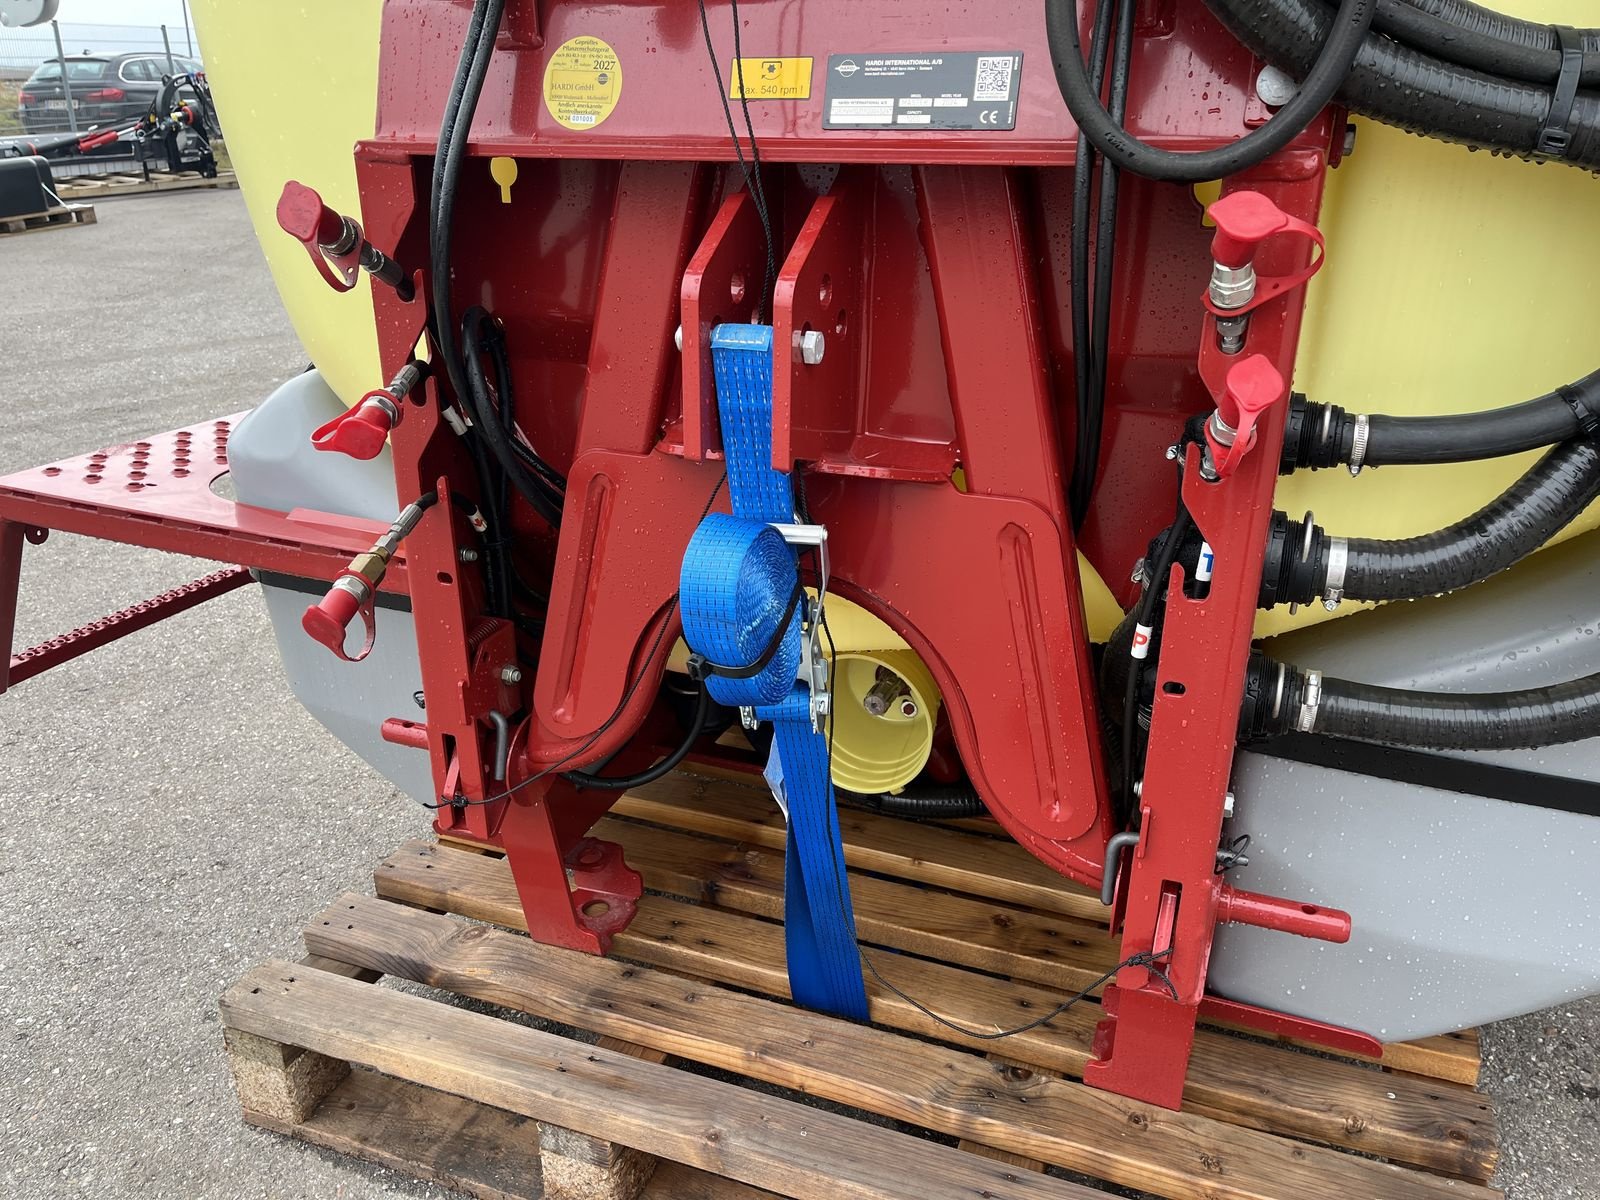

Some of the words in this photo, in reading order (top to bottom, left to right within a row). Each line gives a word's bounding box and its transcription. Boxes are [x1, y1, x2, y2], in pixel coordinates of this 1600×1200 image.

[593, 60, 616, 71] 2027
[761, 85, 778, 94] 540
[780, 86, 797, 96] rpm
[1203, 553, 1214, 572] T
[1132, 631, 1148, 648] P
